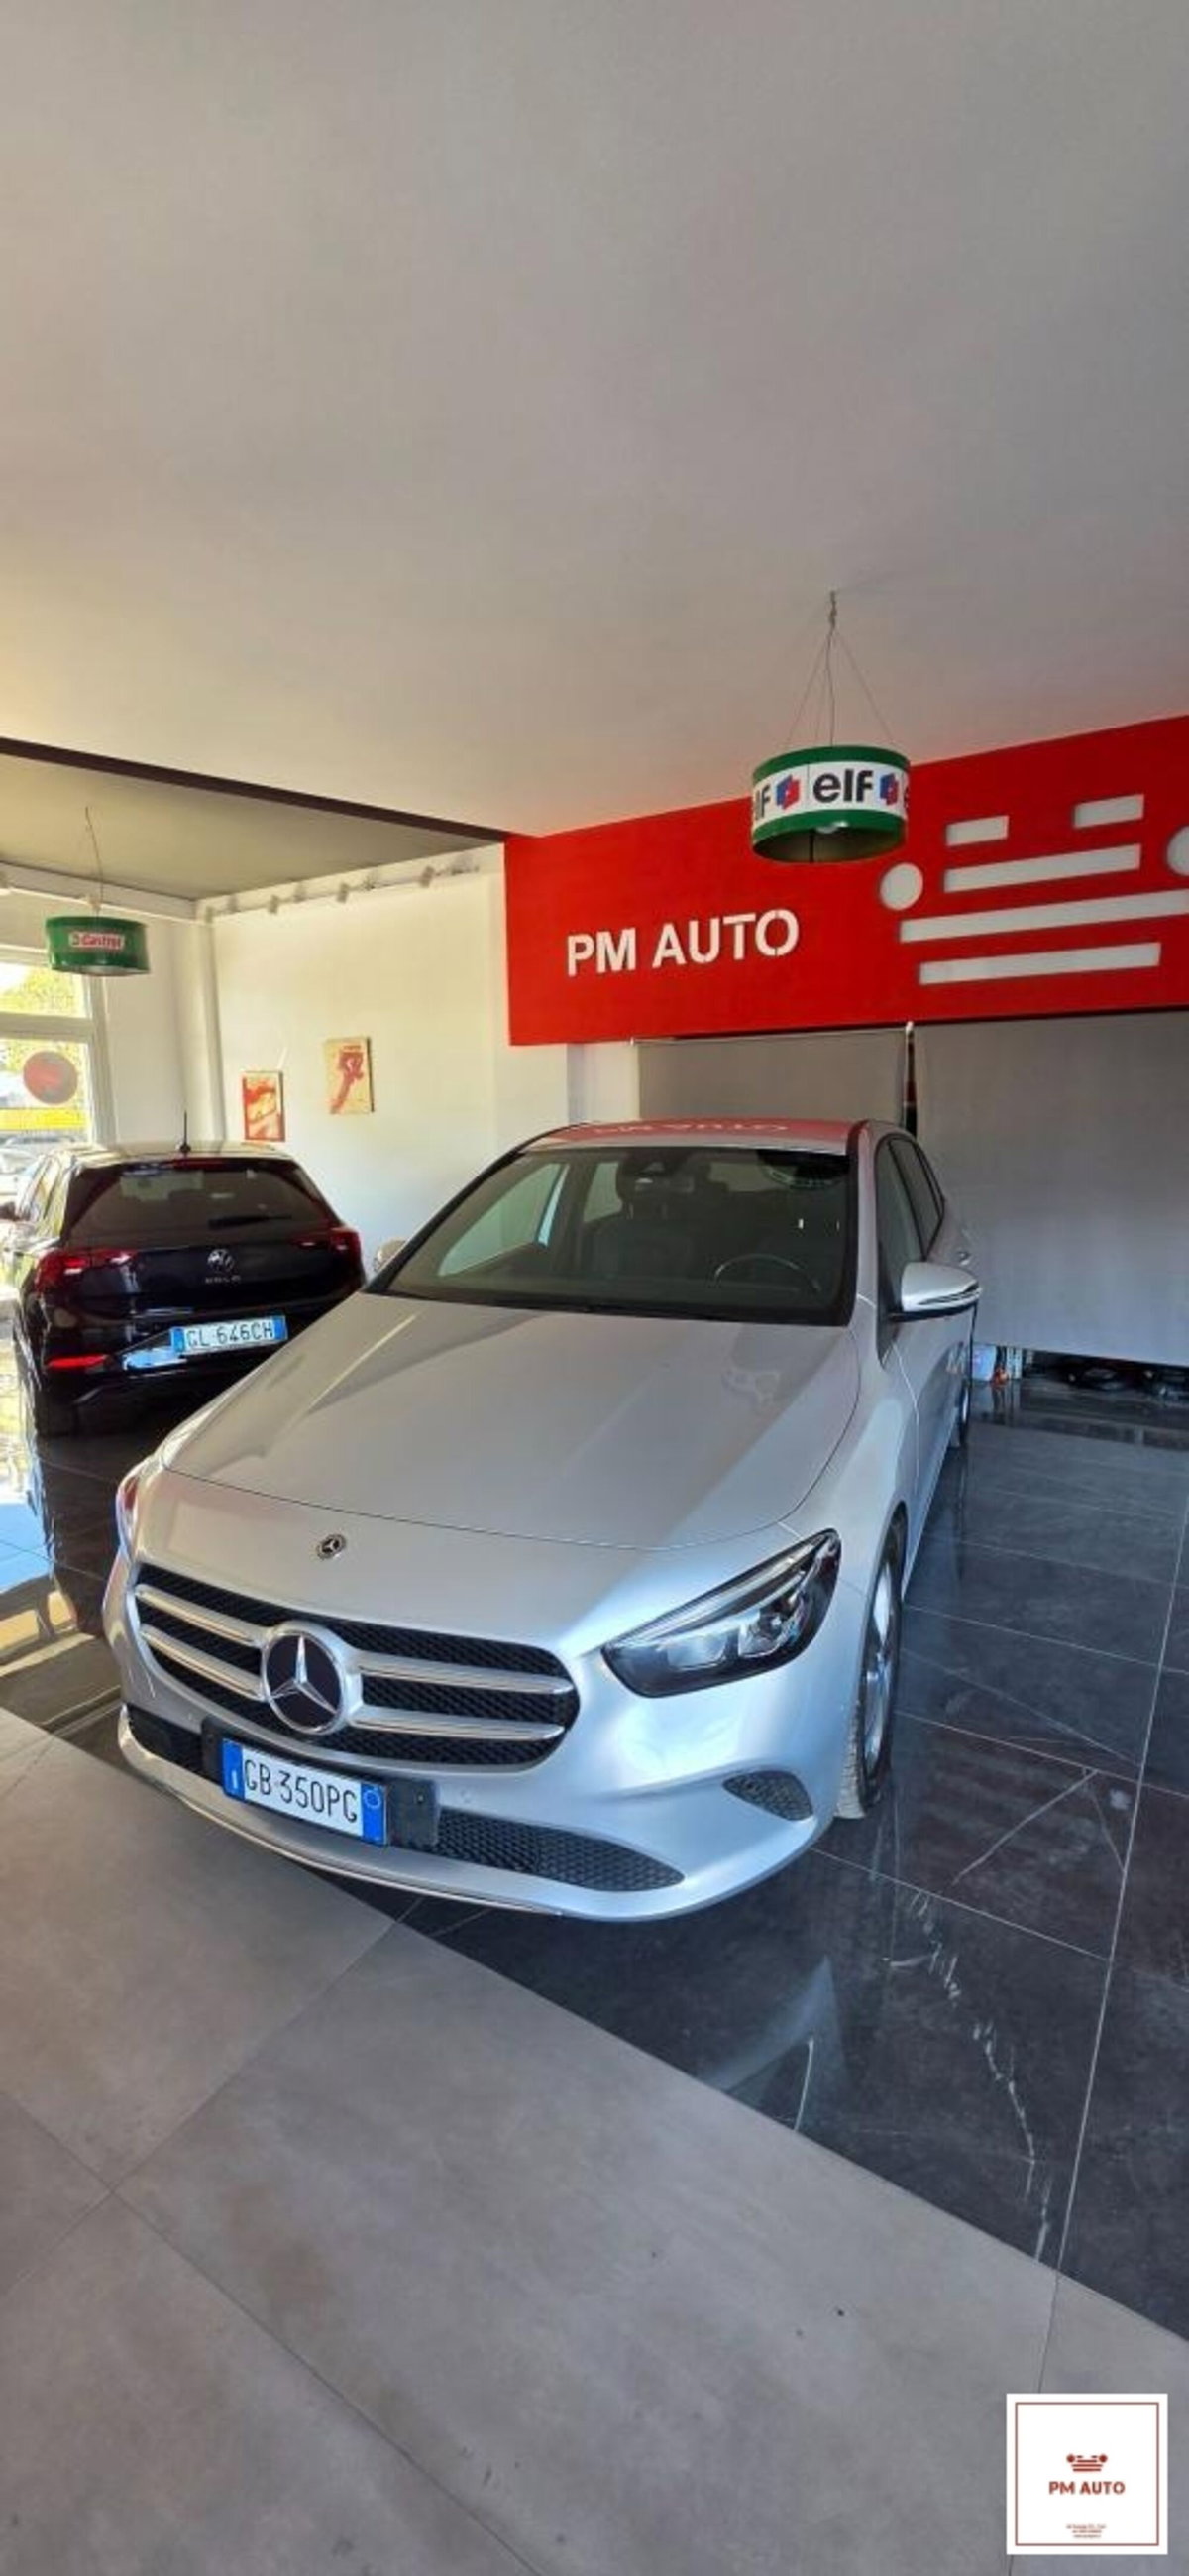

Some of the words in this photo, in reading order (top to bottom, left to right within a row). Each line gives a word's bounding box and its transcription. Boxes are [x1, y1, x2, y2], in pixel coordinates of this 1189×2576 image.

[754, 784, 771, 820] lf
[812, 769, 874, 803] elf
[567, 927, 636, 977] PM
[651, 908, 800, 969] AUTO
[186, 1329, 210, 1347] GL
[216, 1321, 273, 1344] 646CH
[244, 1759, 272, 1796] GB
[278, 1770, 358, 1824] 350PG
